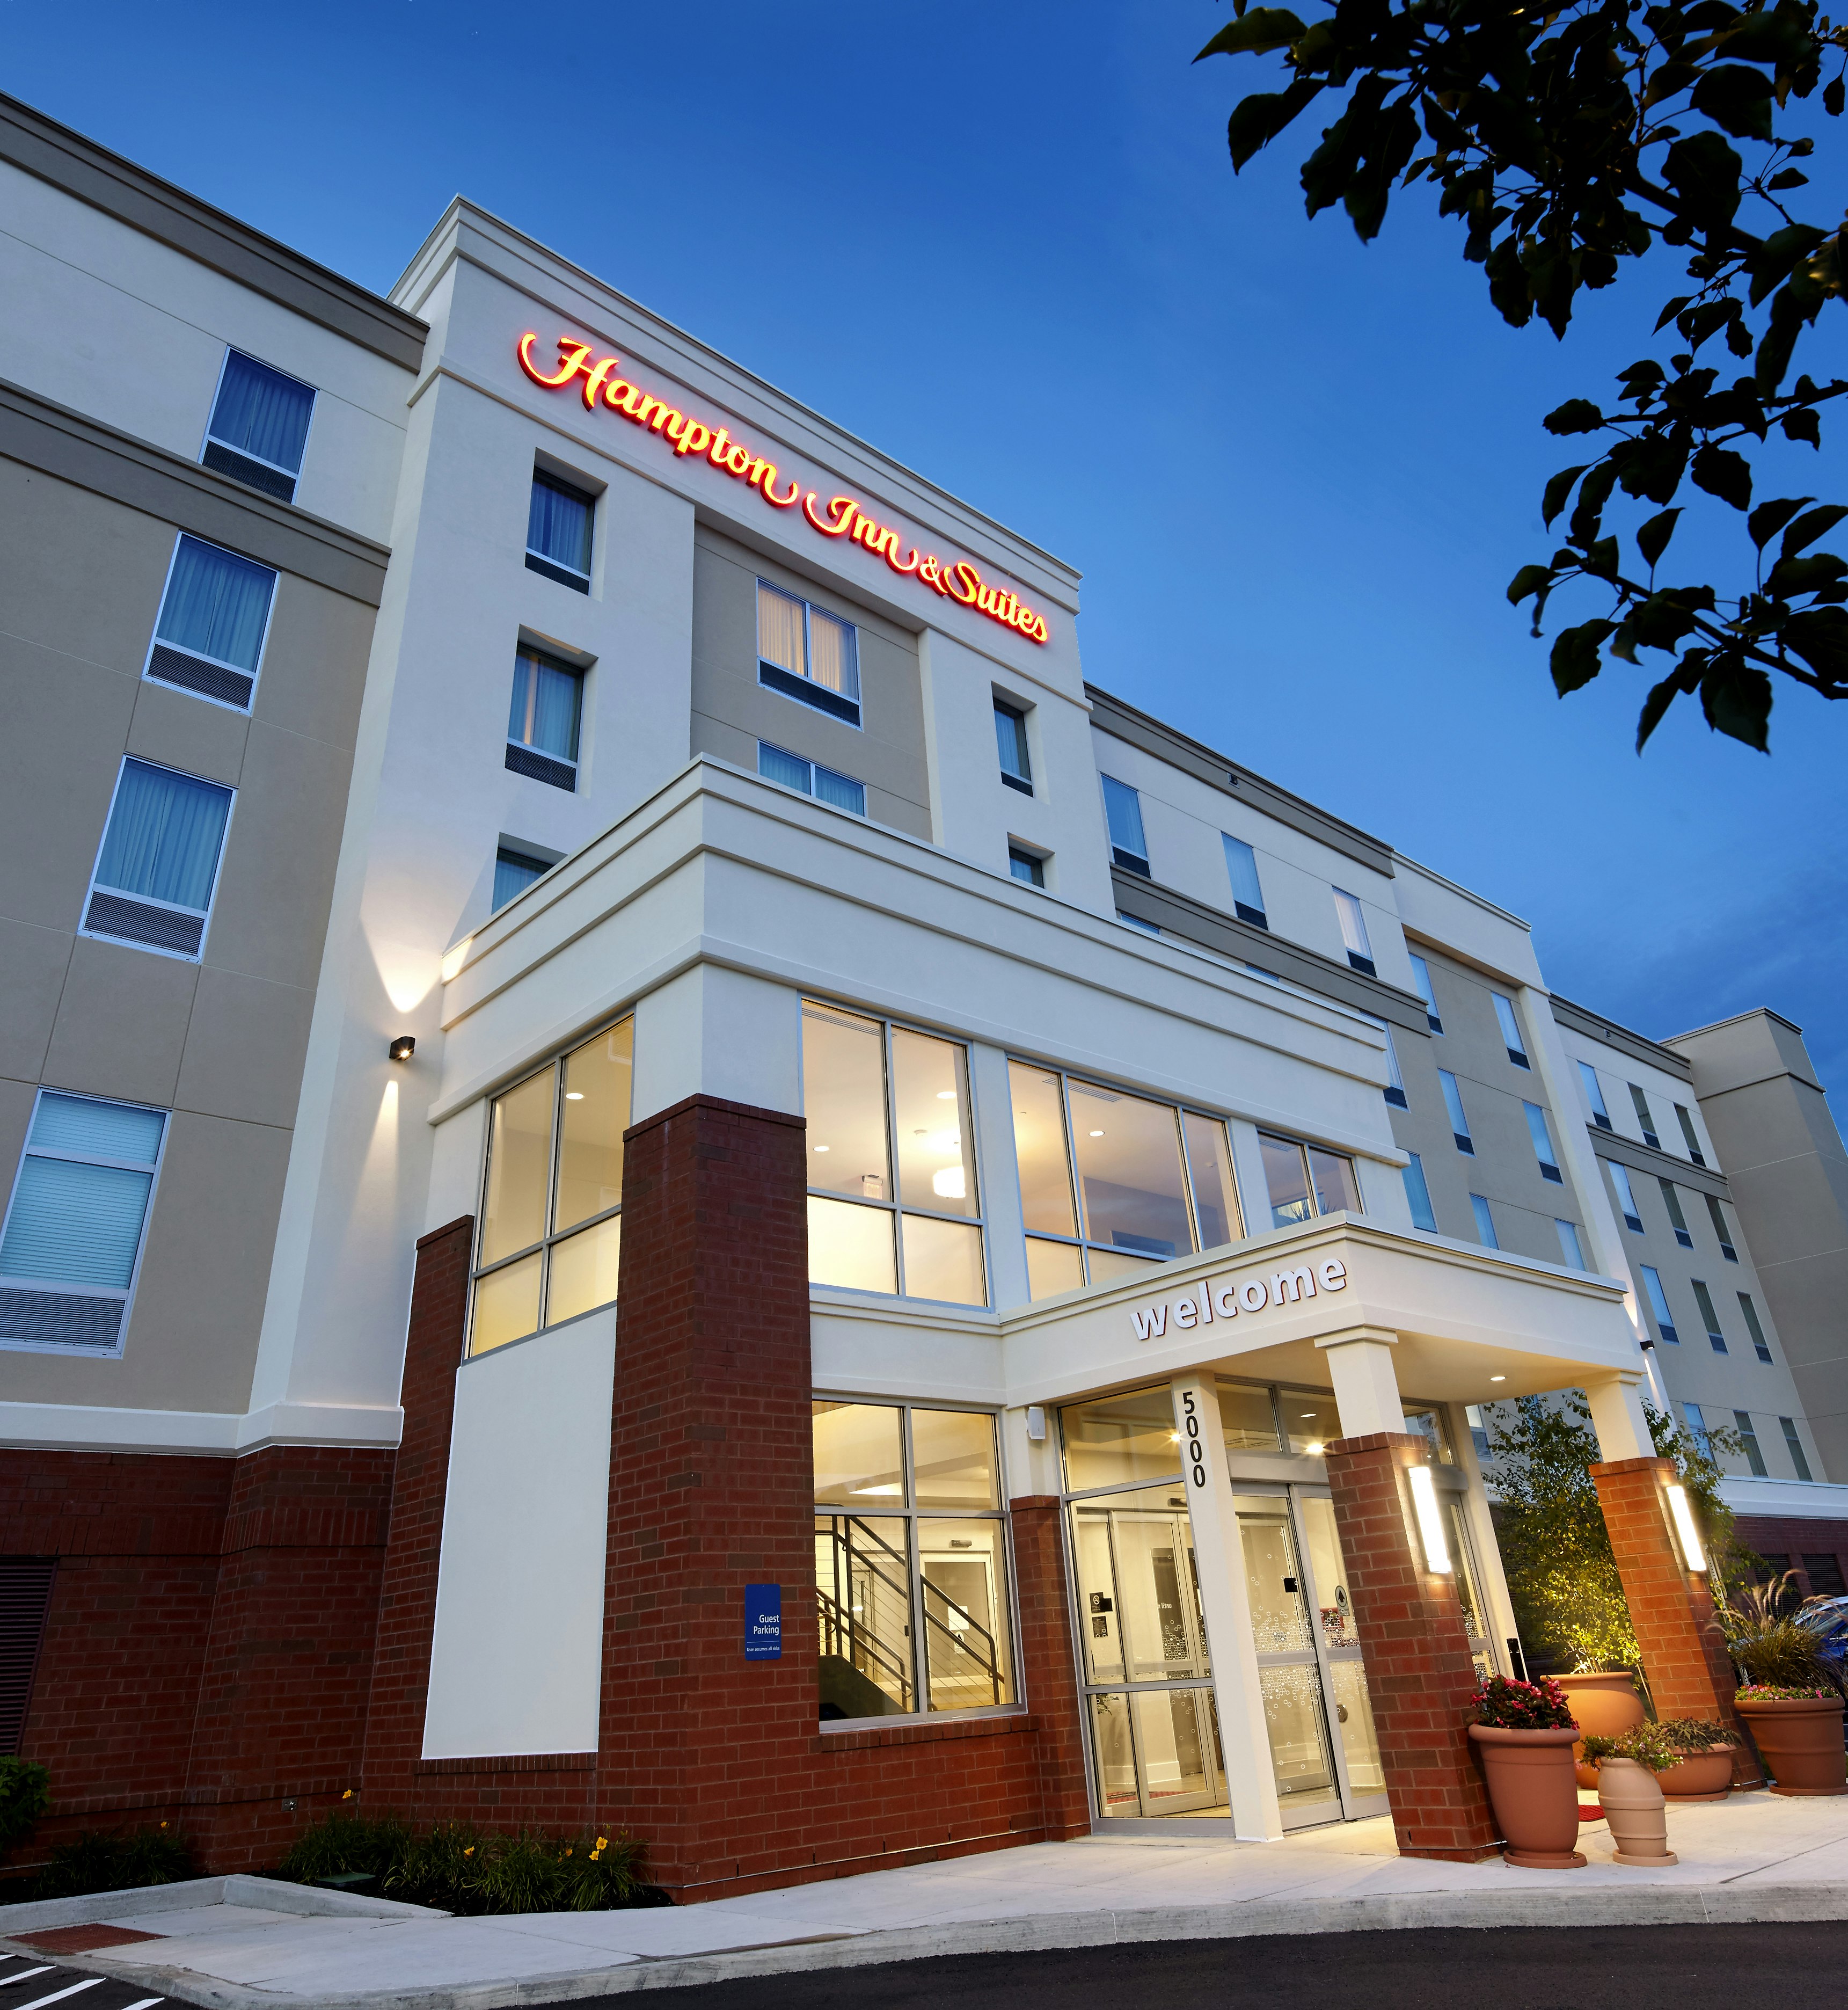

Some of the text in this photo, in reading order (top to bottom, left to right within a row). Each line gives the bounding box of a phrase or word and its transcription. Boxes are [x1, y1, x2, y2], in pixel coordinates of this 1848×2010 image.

[517, 333, 1047, 644] Hampton Inn & Suites
[1130, 1258, 1347, 1341] welcome
[1182, 1391, 1206, 1488] 5000
[754, 1625, 779, 1636] Parking
[759, 1614, 779, 1623] Guest
